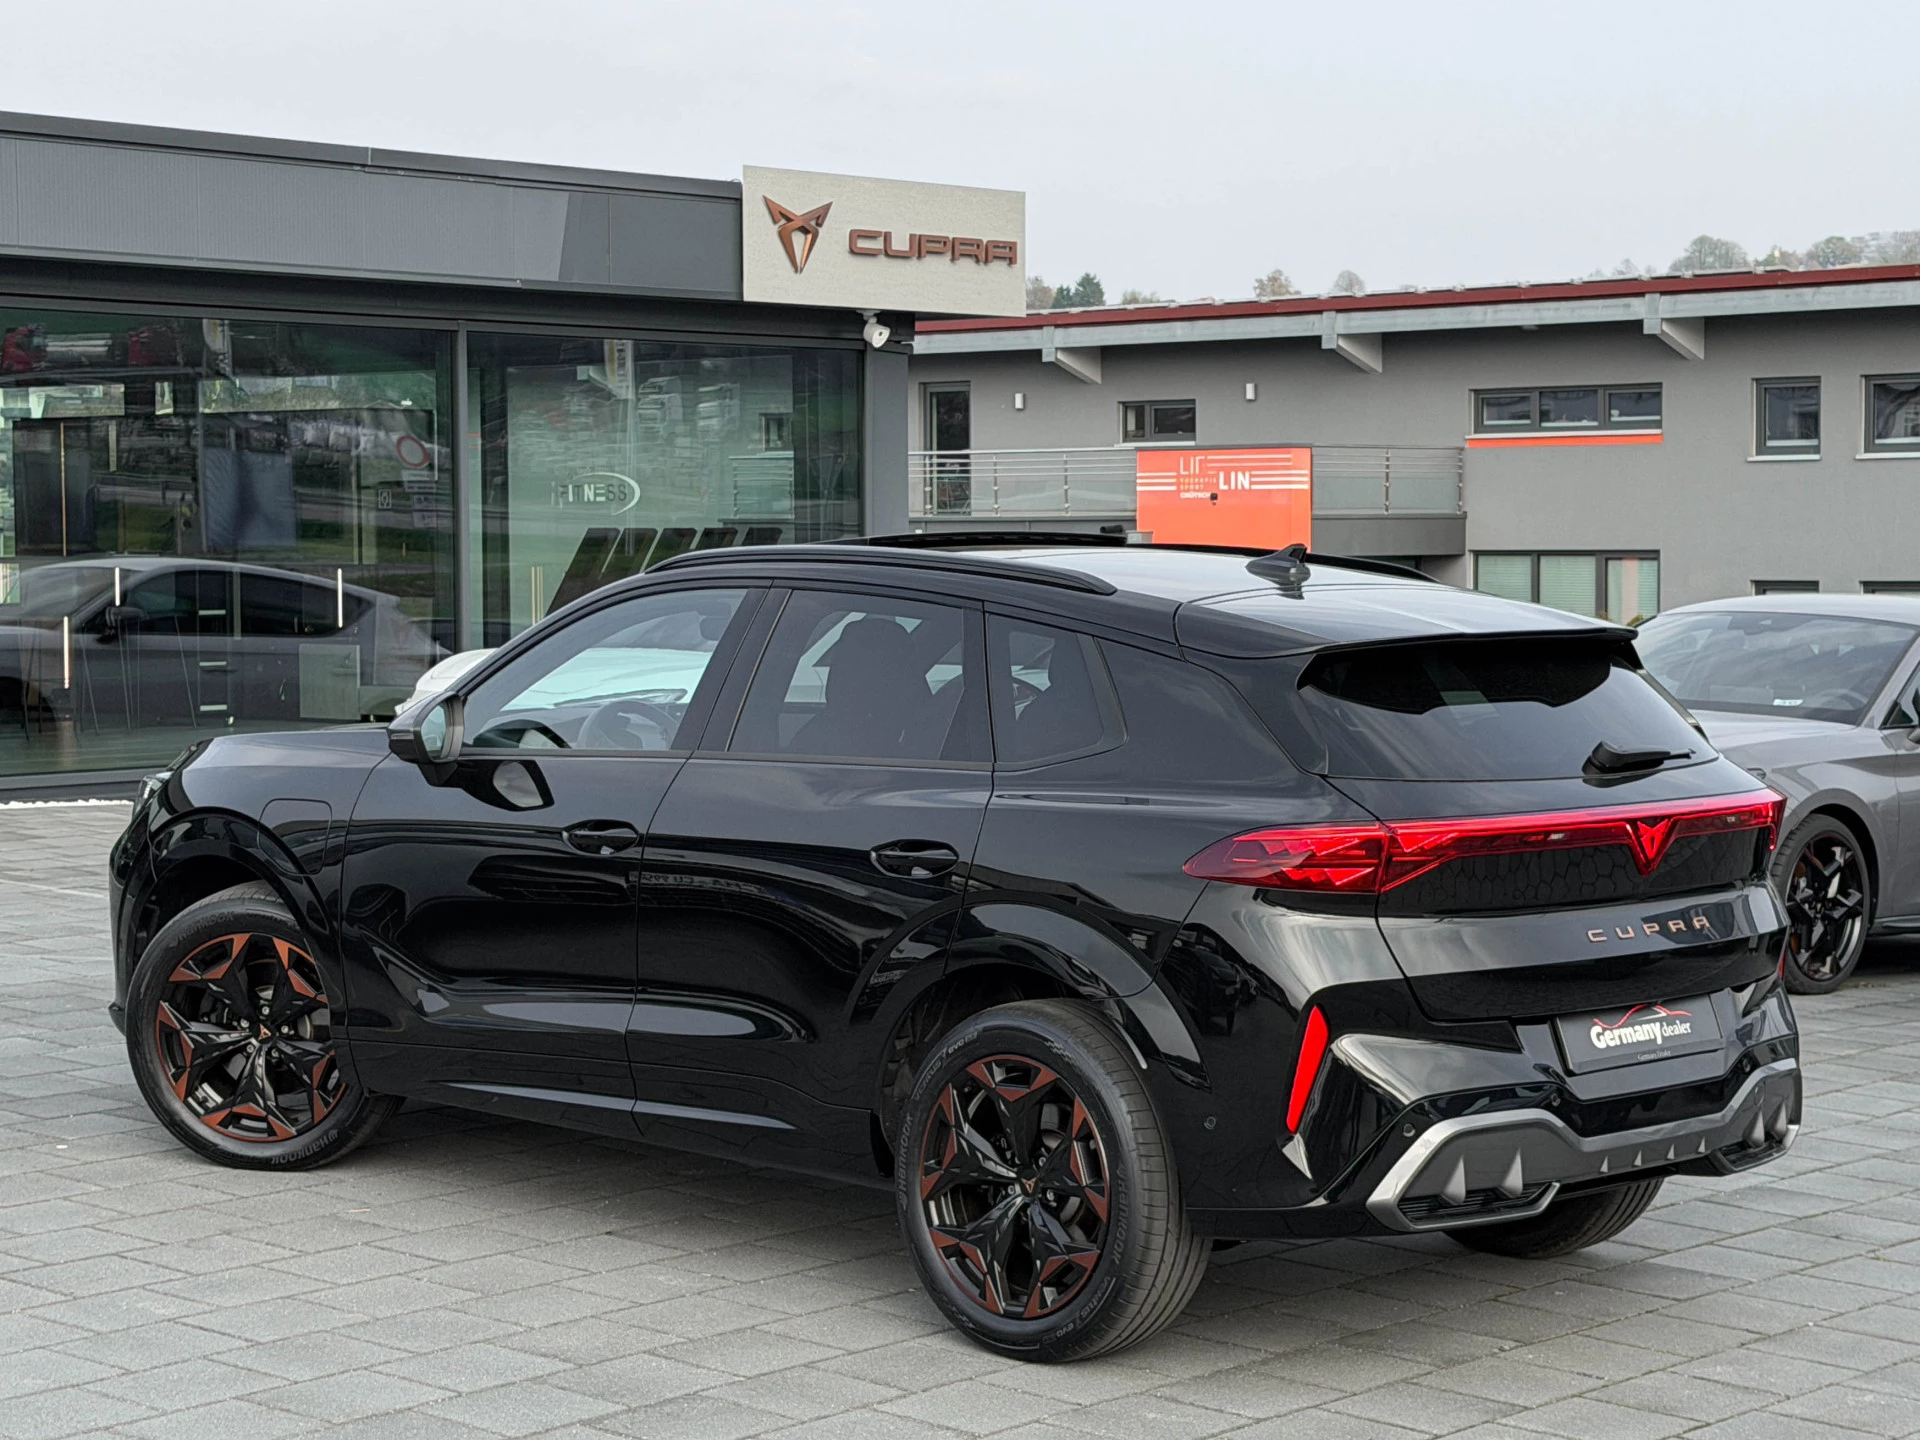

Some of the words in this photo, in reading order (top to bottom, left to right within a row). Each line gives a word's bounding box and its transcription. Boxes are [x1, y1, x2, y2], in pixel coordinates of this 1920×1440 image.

[849, 228, 1018, 266] CUPRA
[558, 483, 627, 502] FITNESS
[1586, 916, 1710, 942] CUPRA
[1590, 1021, 1663, 1049] Germany
[1662, 1020, 1692, 1037] dealer
